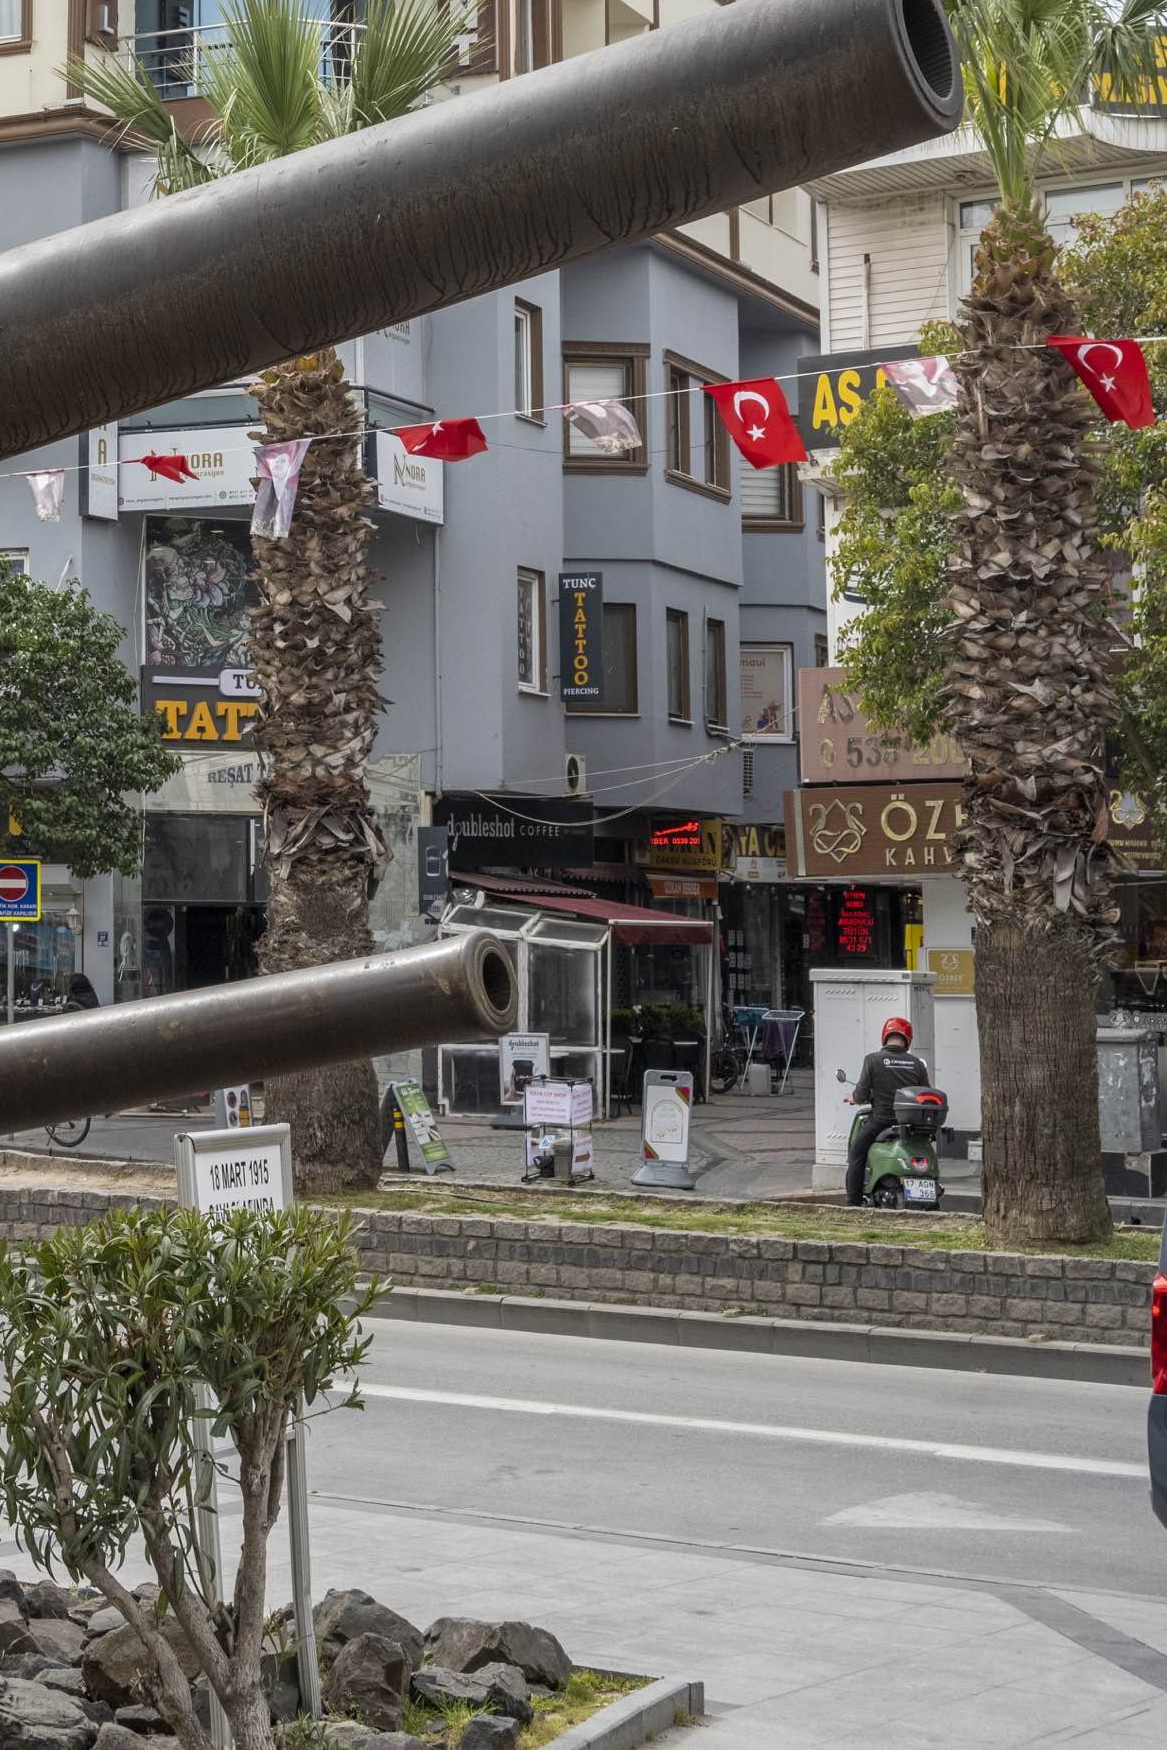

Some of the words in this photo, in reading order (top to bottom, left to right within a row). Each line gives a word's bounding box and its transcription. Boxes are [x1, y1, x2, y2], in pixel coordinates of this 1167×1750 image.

[186, 452, 224, 469] ORA
[574, 592, 588, 685] TATTOO
[233, 674, 262, 690] TU
[563, 687, 599, 696] PIERCING
[447, 812, 515, 839] doubleshot
[519, 825, 560, 838] COFFEE
[209, 1164, 221, 1191] 18
[221, 1161, 246, 1190] MART
[248, 1158, 270, 1187] 1915
